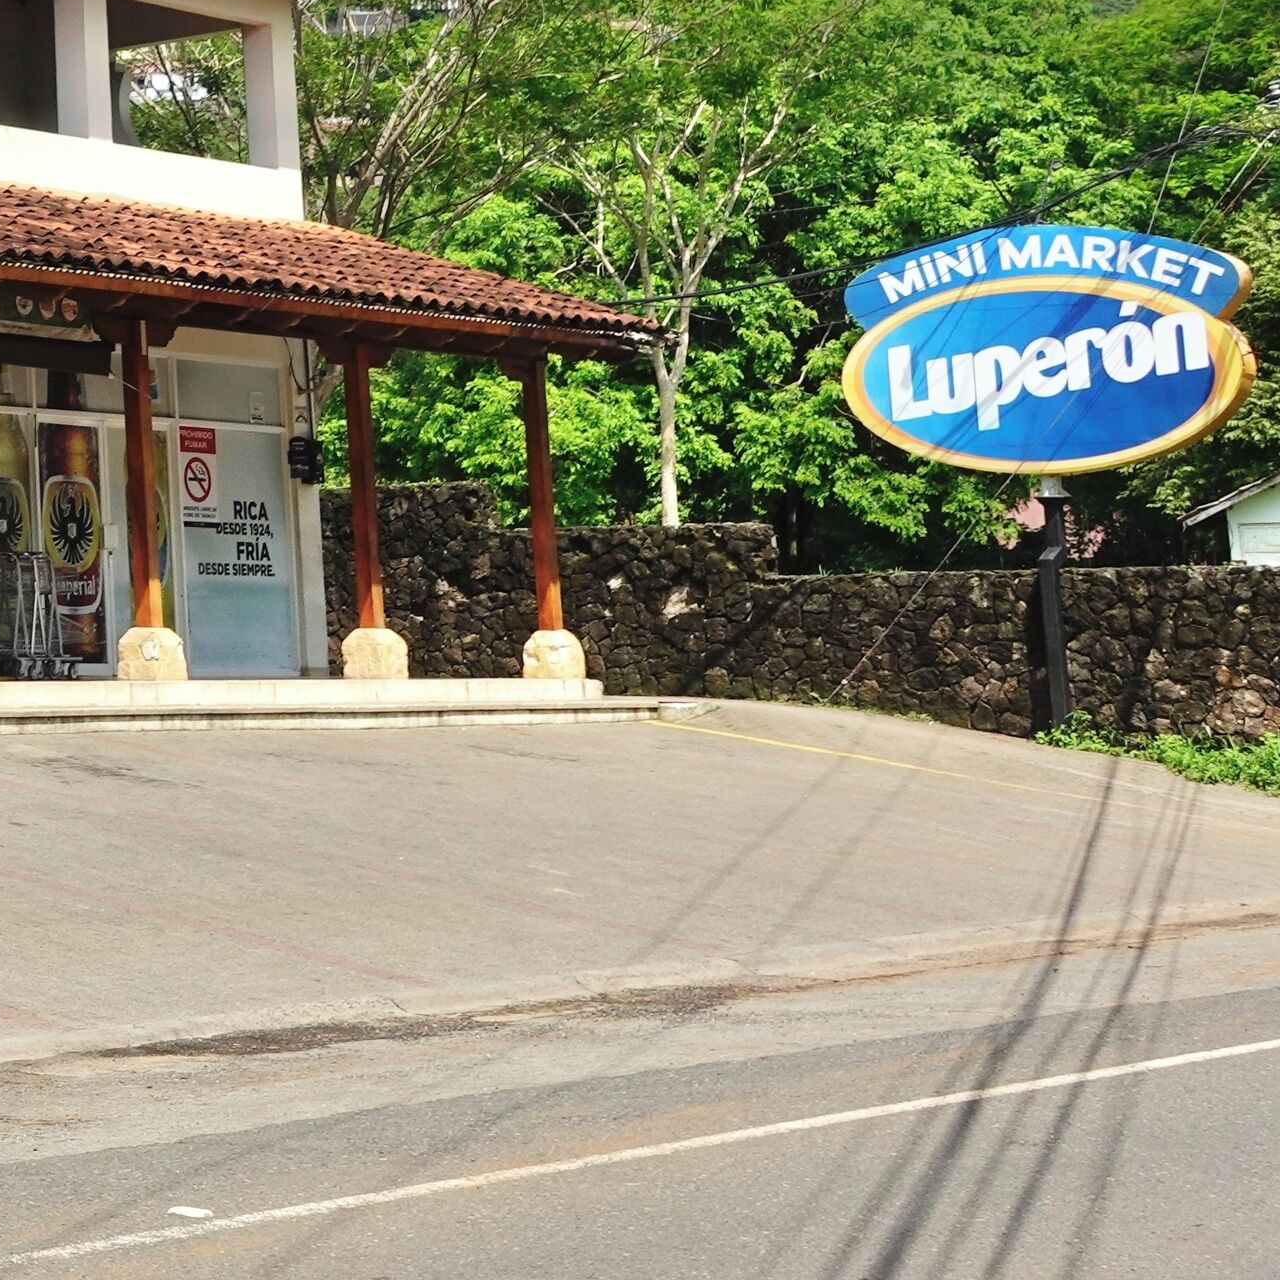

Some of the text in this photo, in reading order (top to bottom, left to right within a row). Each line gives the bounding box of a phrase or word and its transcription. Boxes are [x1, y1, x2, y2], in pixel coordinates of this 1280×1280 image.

[877, 233, 1225, 304] MINI MARKET
[887, 300, 1210, 431] Luperón
[180, 429, 213, 440] PROHIBIDO
[184, 440, 207, 449] FUMAR
[233, 500, 268, 521] RICA
[216, 522, 273, 538] DESDE 1924,
[236, 538, 270, 562] FRÍA
[198, 562, 275, 577] DESDE SIEMPRE.
